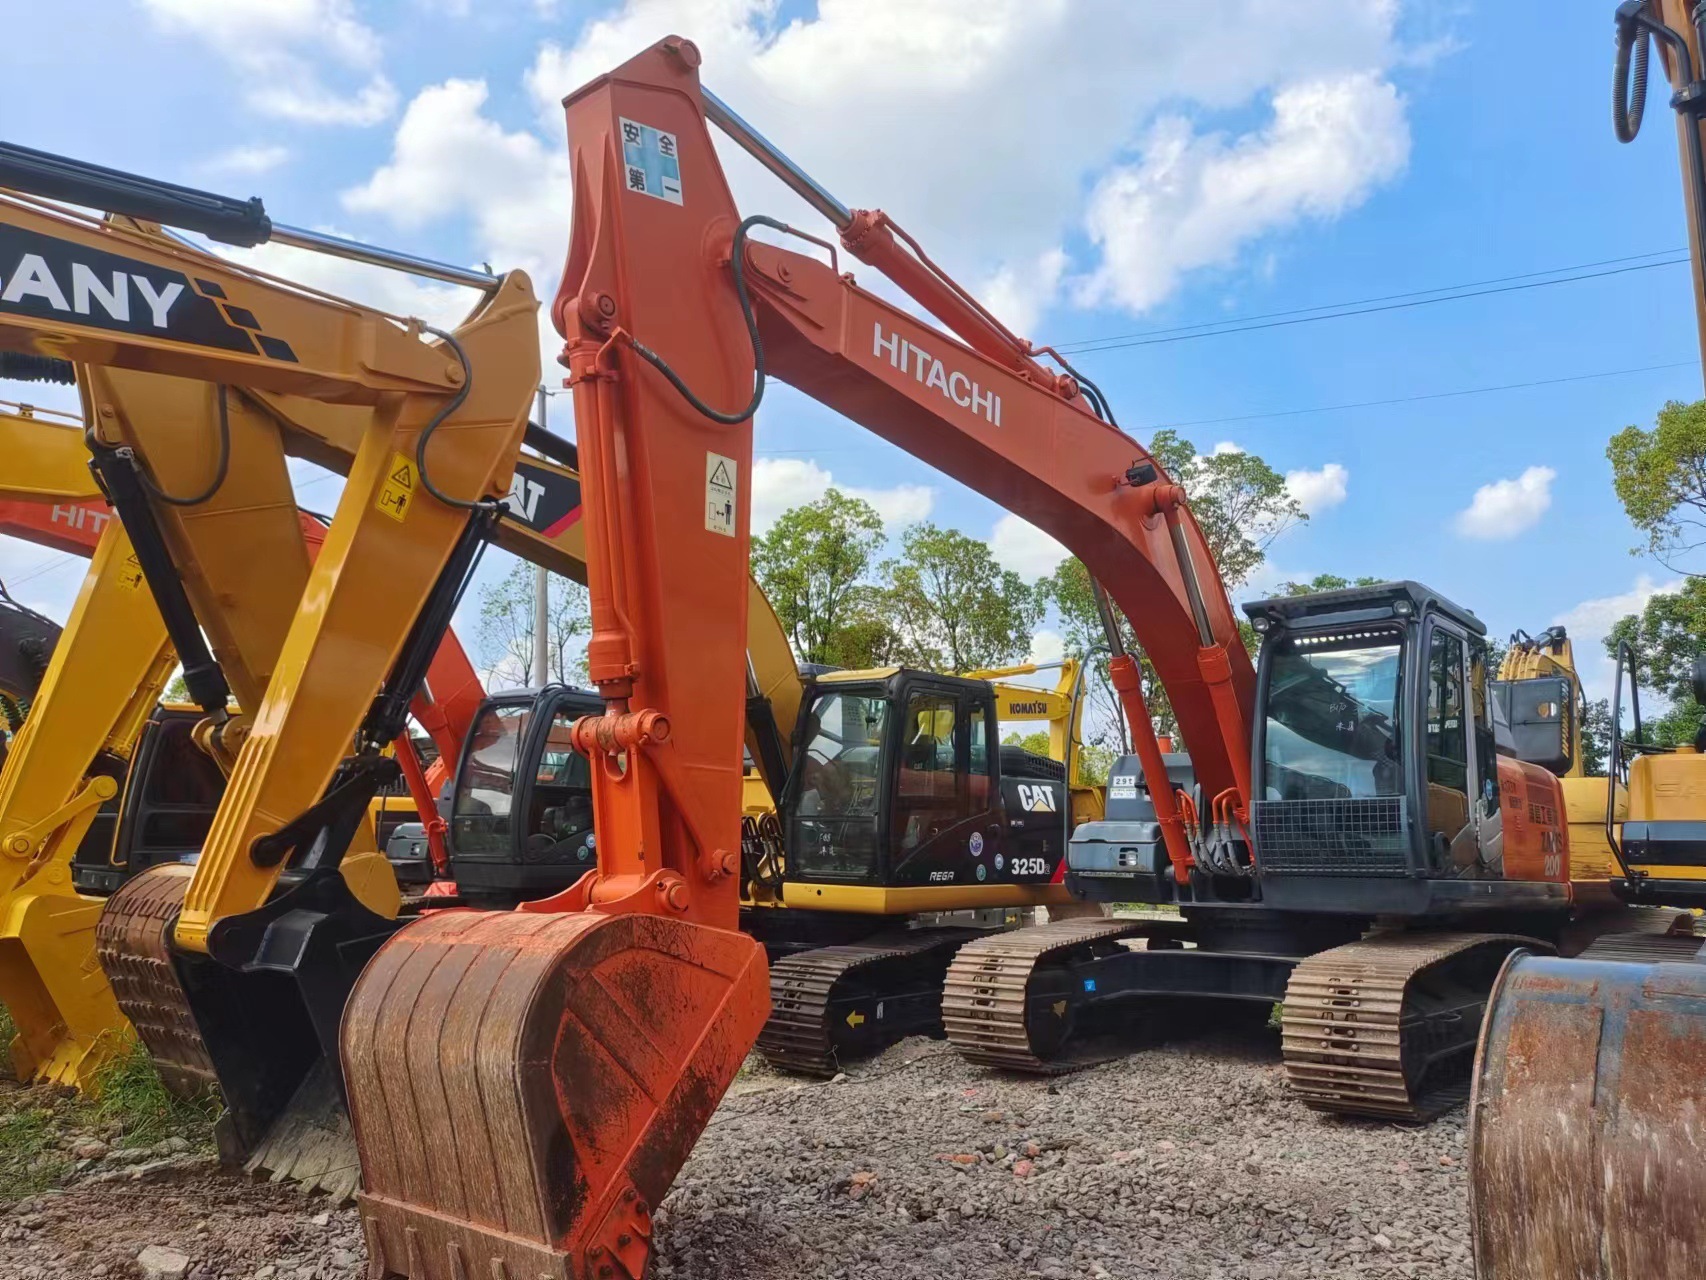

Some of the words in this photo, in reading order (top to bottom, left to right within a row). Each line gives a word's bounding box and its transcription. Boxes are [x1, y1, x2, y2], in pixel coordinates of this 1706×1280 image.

[0, 253, 185, 329] ANY
[873, 321, 1001, 427] HITACHI
[508, 471, 546, 522] AT
[51, 504, 111, 533] HIT
[1009, 701, 1047, 714] KOMATSU
[1017, 784, 1056, 812] CAT
[1544, 855, 1561, 876] 200
